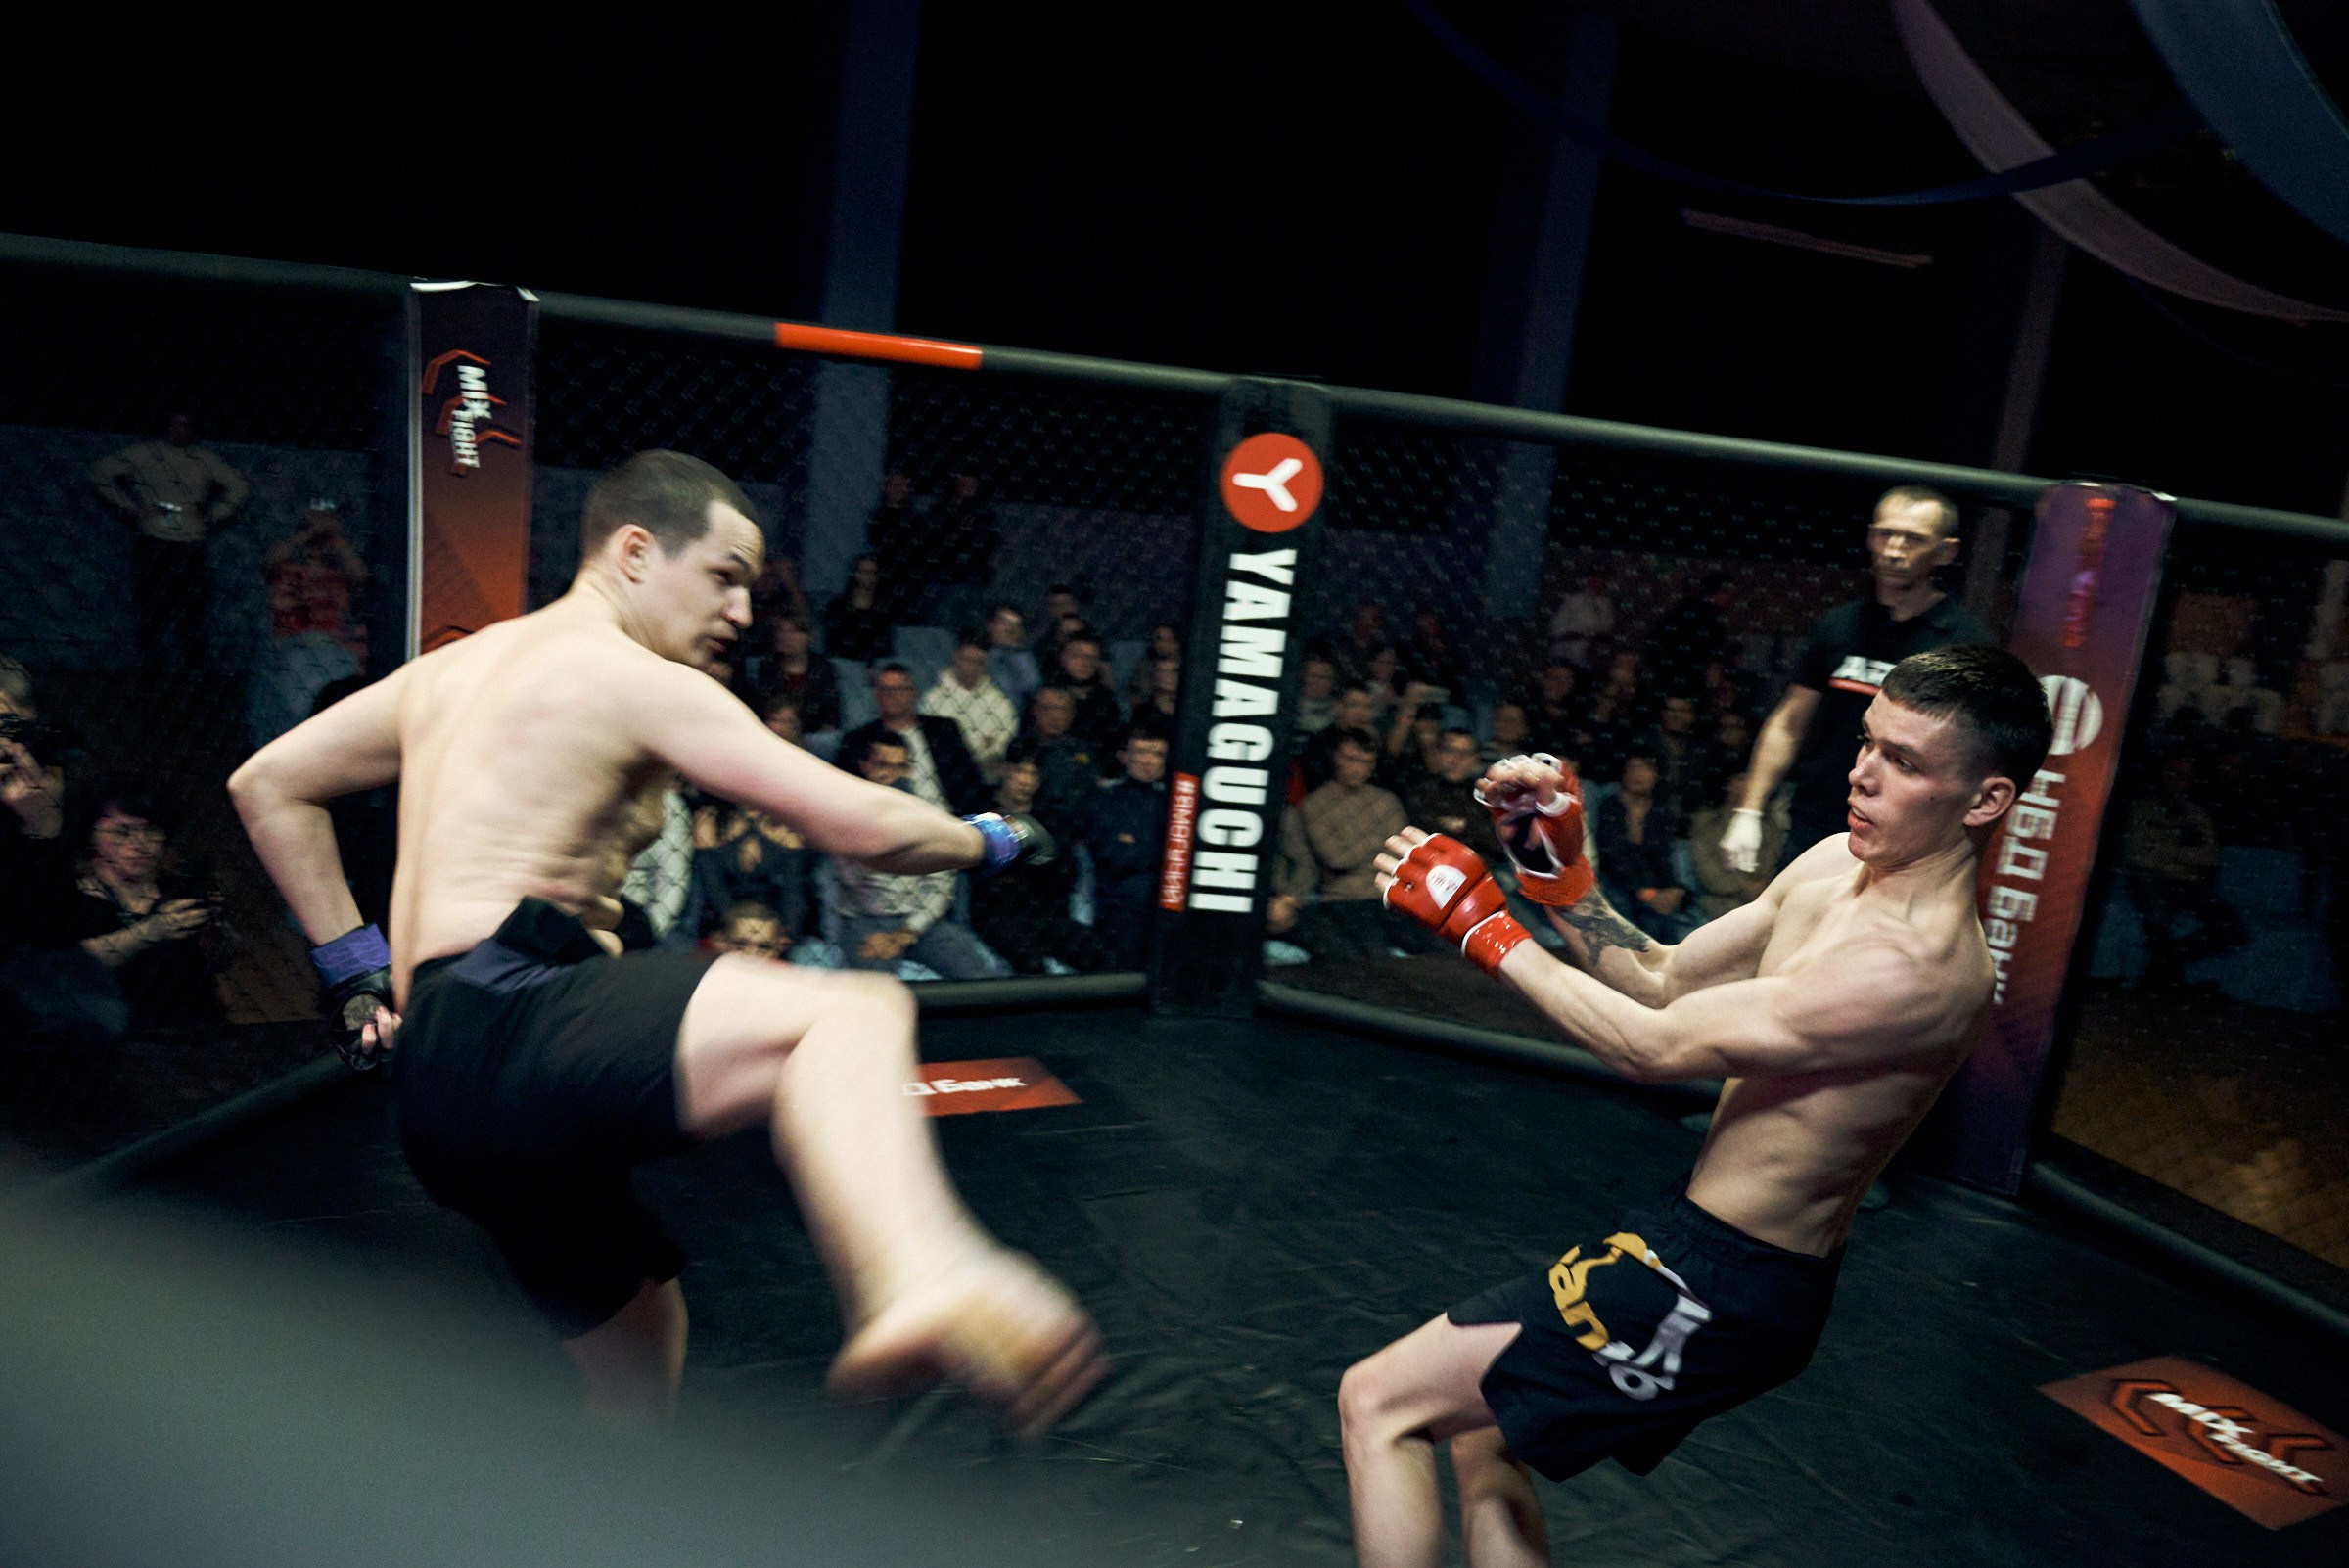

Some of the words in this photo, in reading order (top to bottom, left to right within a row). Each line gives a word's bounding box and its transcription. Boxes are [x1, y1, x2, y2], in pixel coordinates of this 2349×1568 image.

[456, 364, 492, 419] MIX
[450, 409, 481, 468] FIGHT
[1188, 548, 1298, 914] YAMAGUCHI
[2146, 1392, 2255, 1437] MIX
